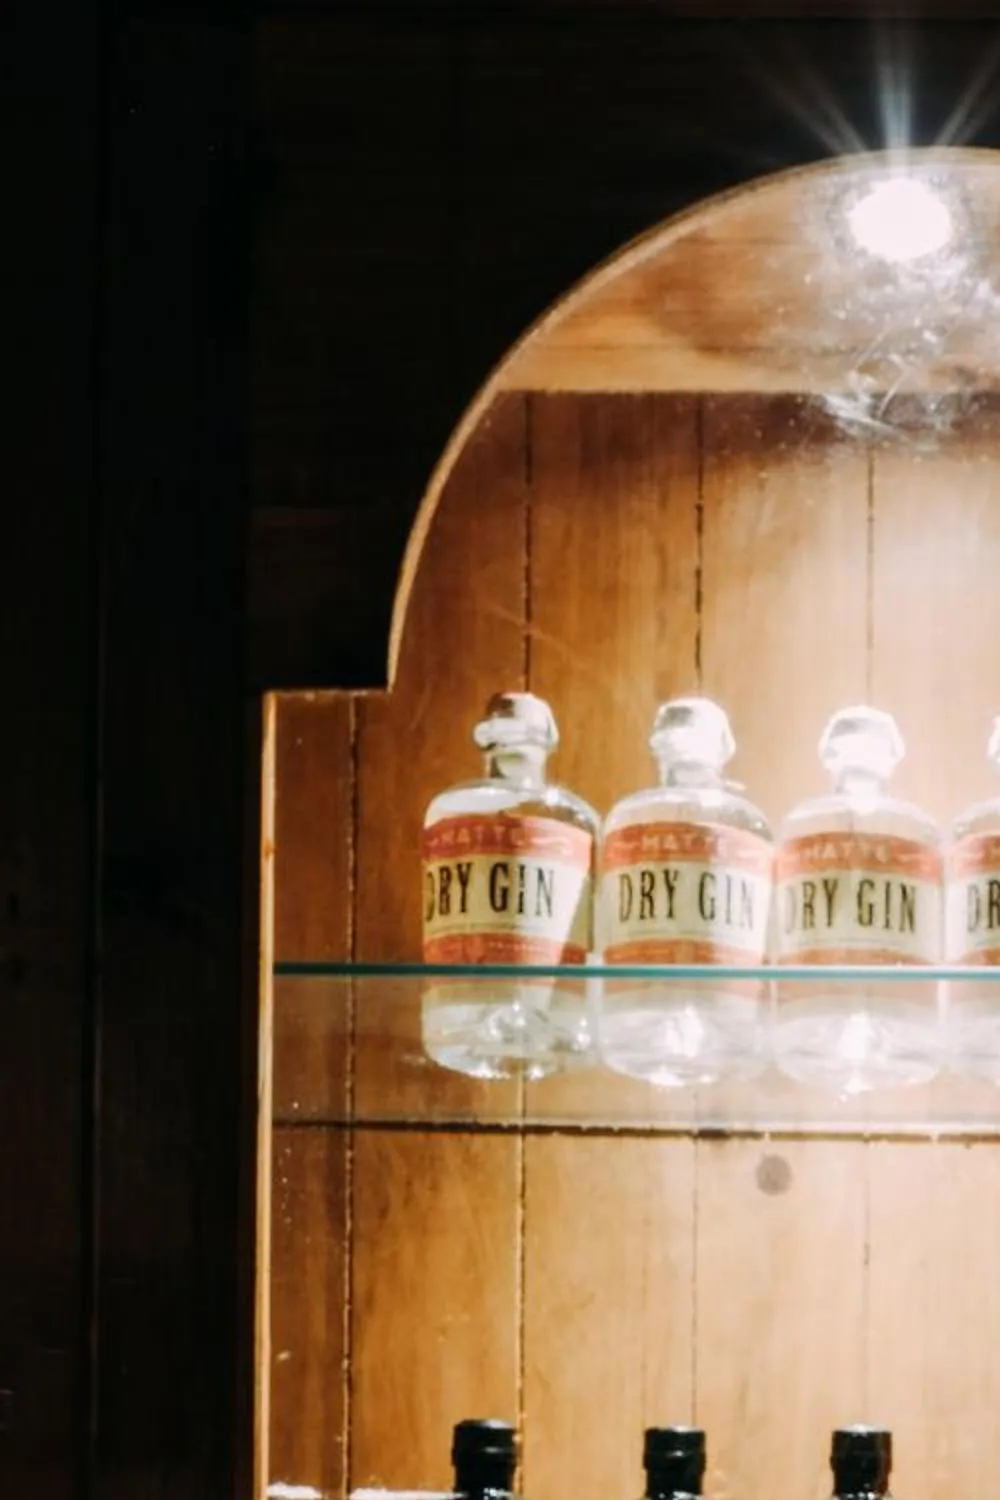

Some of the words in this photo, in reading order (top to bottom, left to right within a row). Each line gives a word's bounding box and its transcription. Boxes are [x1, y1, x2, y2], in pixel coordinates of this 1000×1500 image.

[426, 863, 473, 923] DRY
[489, 863, 554, 918] GIN
[618, 870, 680, 923] DRY
[698, 872, 753, 929] GIN
[785, 878, 838, 935] DRY
[856, 879, 916, 934] GIN
